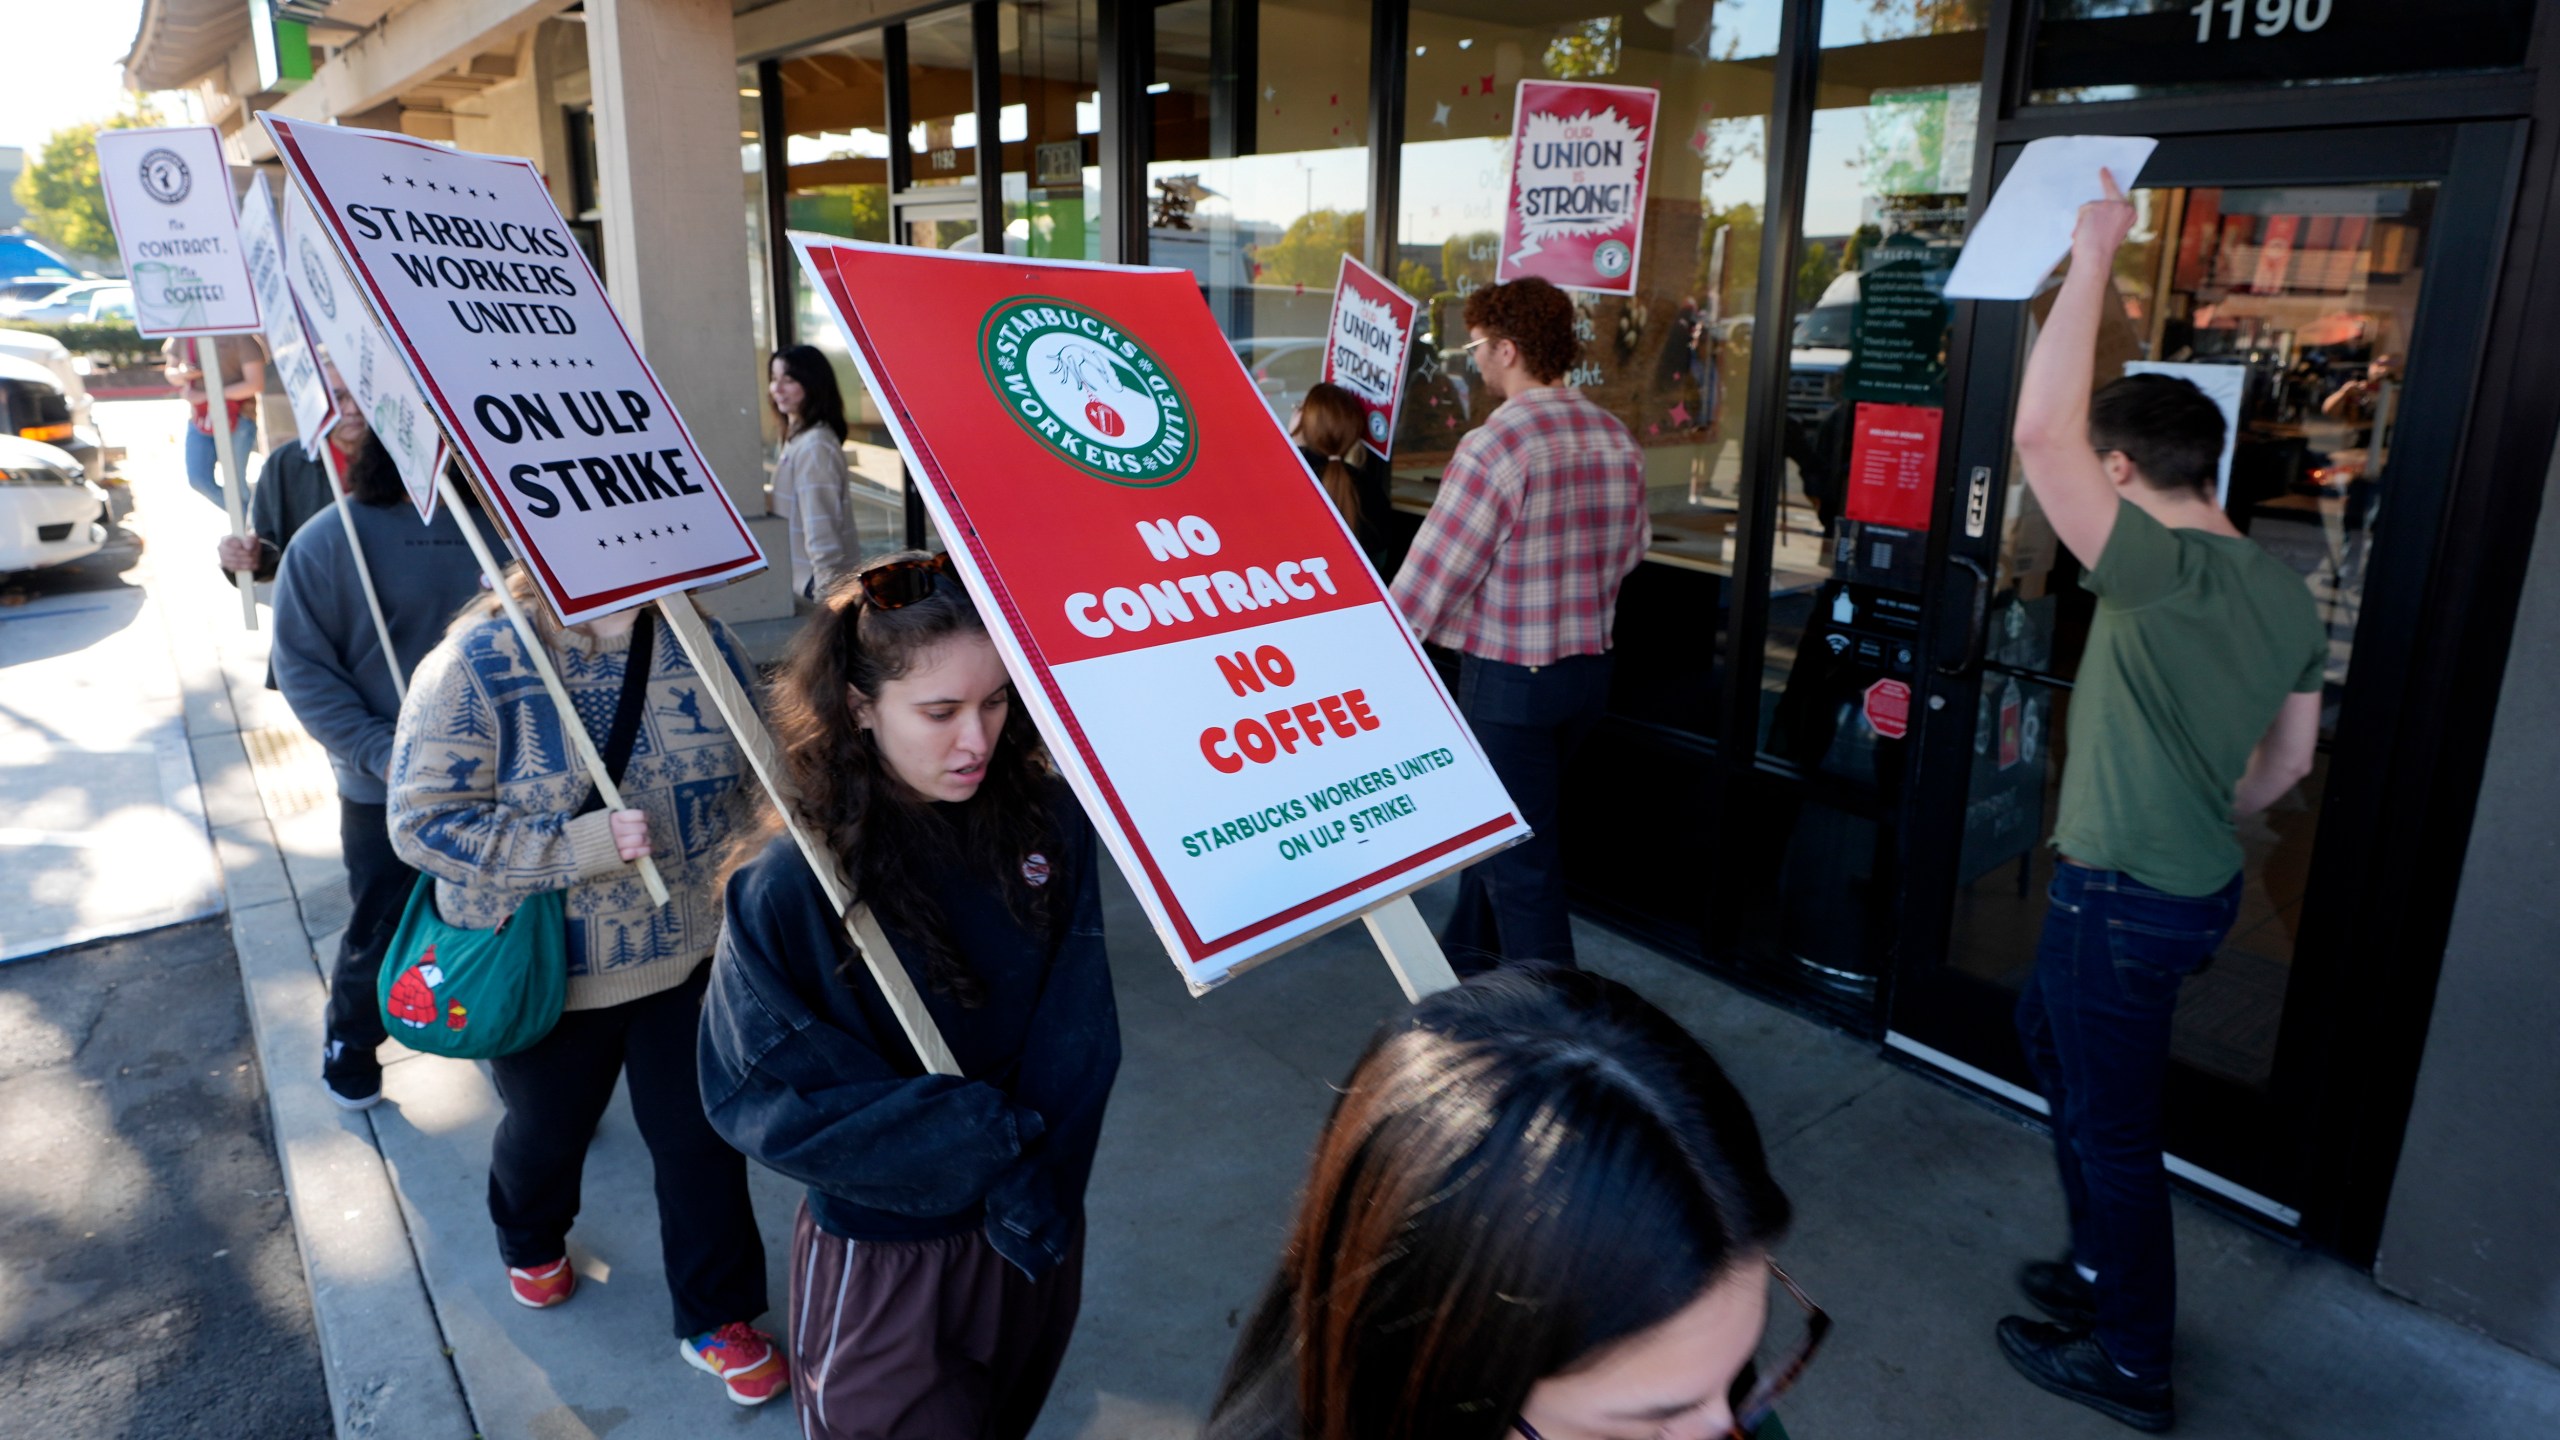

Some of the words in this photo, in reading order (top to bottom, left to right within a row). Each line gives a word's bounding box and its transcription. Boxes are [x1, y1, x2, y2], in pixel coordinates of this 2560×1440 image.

[2190, 0, 2333, 43] 1190
[1533, 140, 1622, 170] UNION
[1564, 126, 1594, 139] OUR
[1525, 183, 1631, 217] STRONG!
[346, 203, 569, 258] STARBUCKS
[391, 253, 577, 297] WORKERS
[447, 300, 577, 335] UNITED
[996, 307, 1138, 359] STARBUCKS
[1343, 310, 1392, 356] UNION
[1336, 345, 1392, 396] STRONG!
[473, 393, 565, 444] ON
[558, 390, 651, 437] ULP
[1004, 373, 1143, 474] WORKERS
[1148, 374, 1186, 466] UNITED
[509, 448, 704, 518] STRIKE
[1135, 515, 1221, 562] NO
[1064, 557, 1337, 639] CONTRACT
[1215, 645, 1295, 697] NO
[1199, 689, 1380, 774] COFFEE
[1181, 799, 1307, 857] STARBUCKS
[1305, 768, 1397, 812] WORKERS
[1394, 747, 1454, 781] UNITED
[1278, 833, 1313, 861] ON
[1310, 820, 1347, 848] ULP
[1350, 793, 1417, 833] STRIKE!
